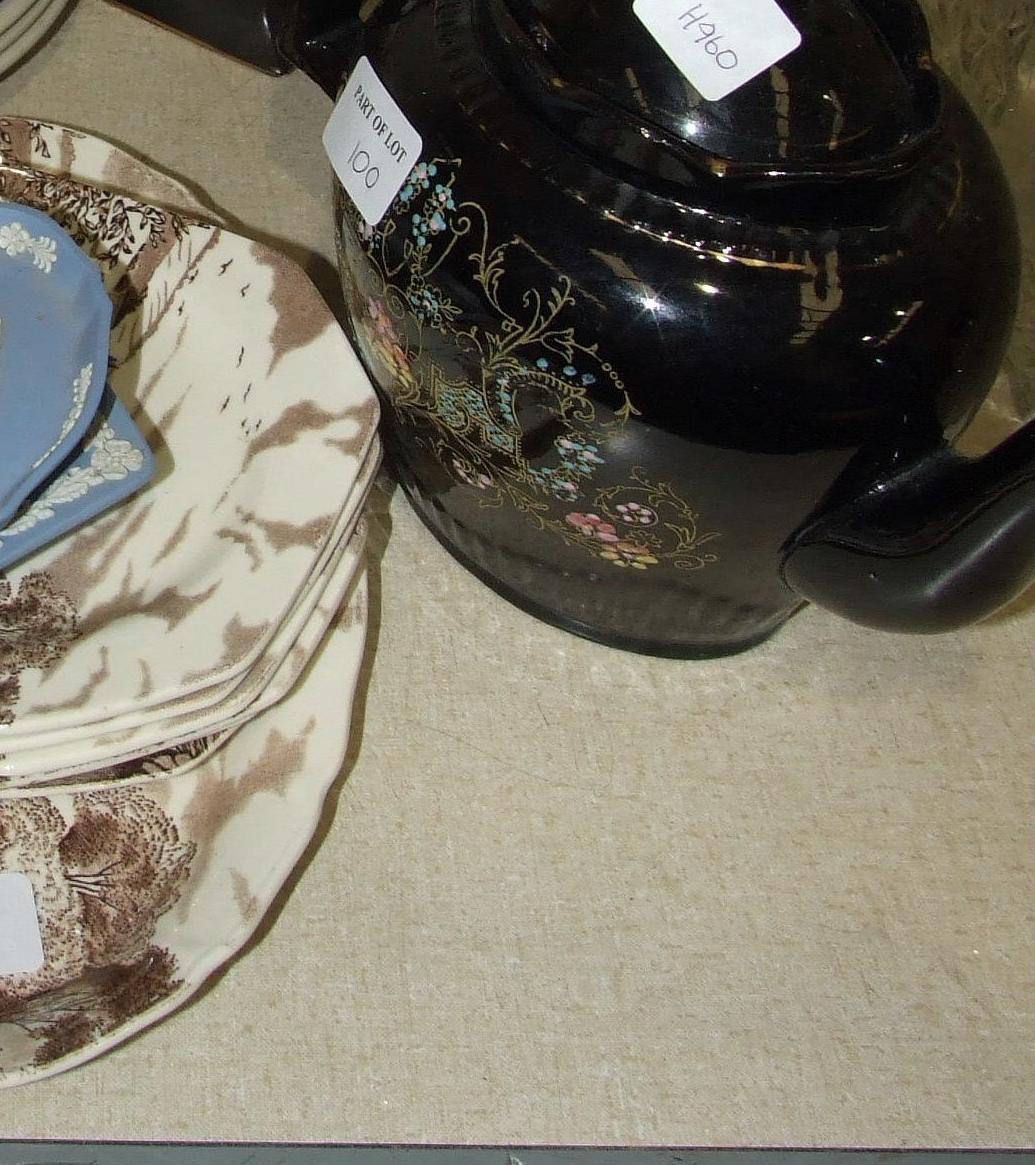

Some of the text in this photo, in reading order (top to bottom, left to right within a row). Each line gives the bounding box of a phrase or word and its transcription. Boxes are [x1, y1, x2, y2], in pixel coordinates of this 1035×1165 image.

[678, 3, 738, 70] H960
[353, 83, 408, 164] PART OF LOT
[347, 139, 380, 189] 100
